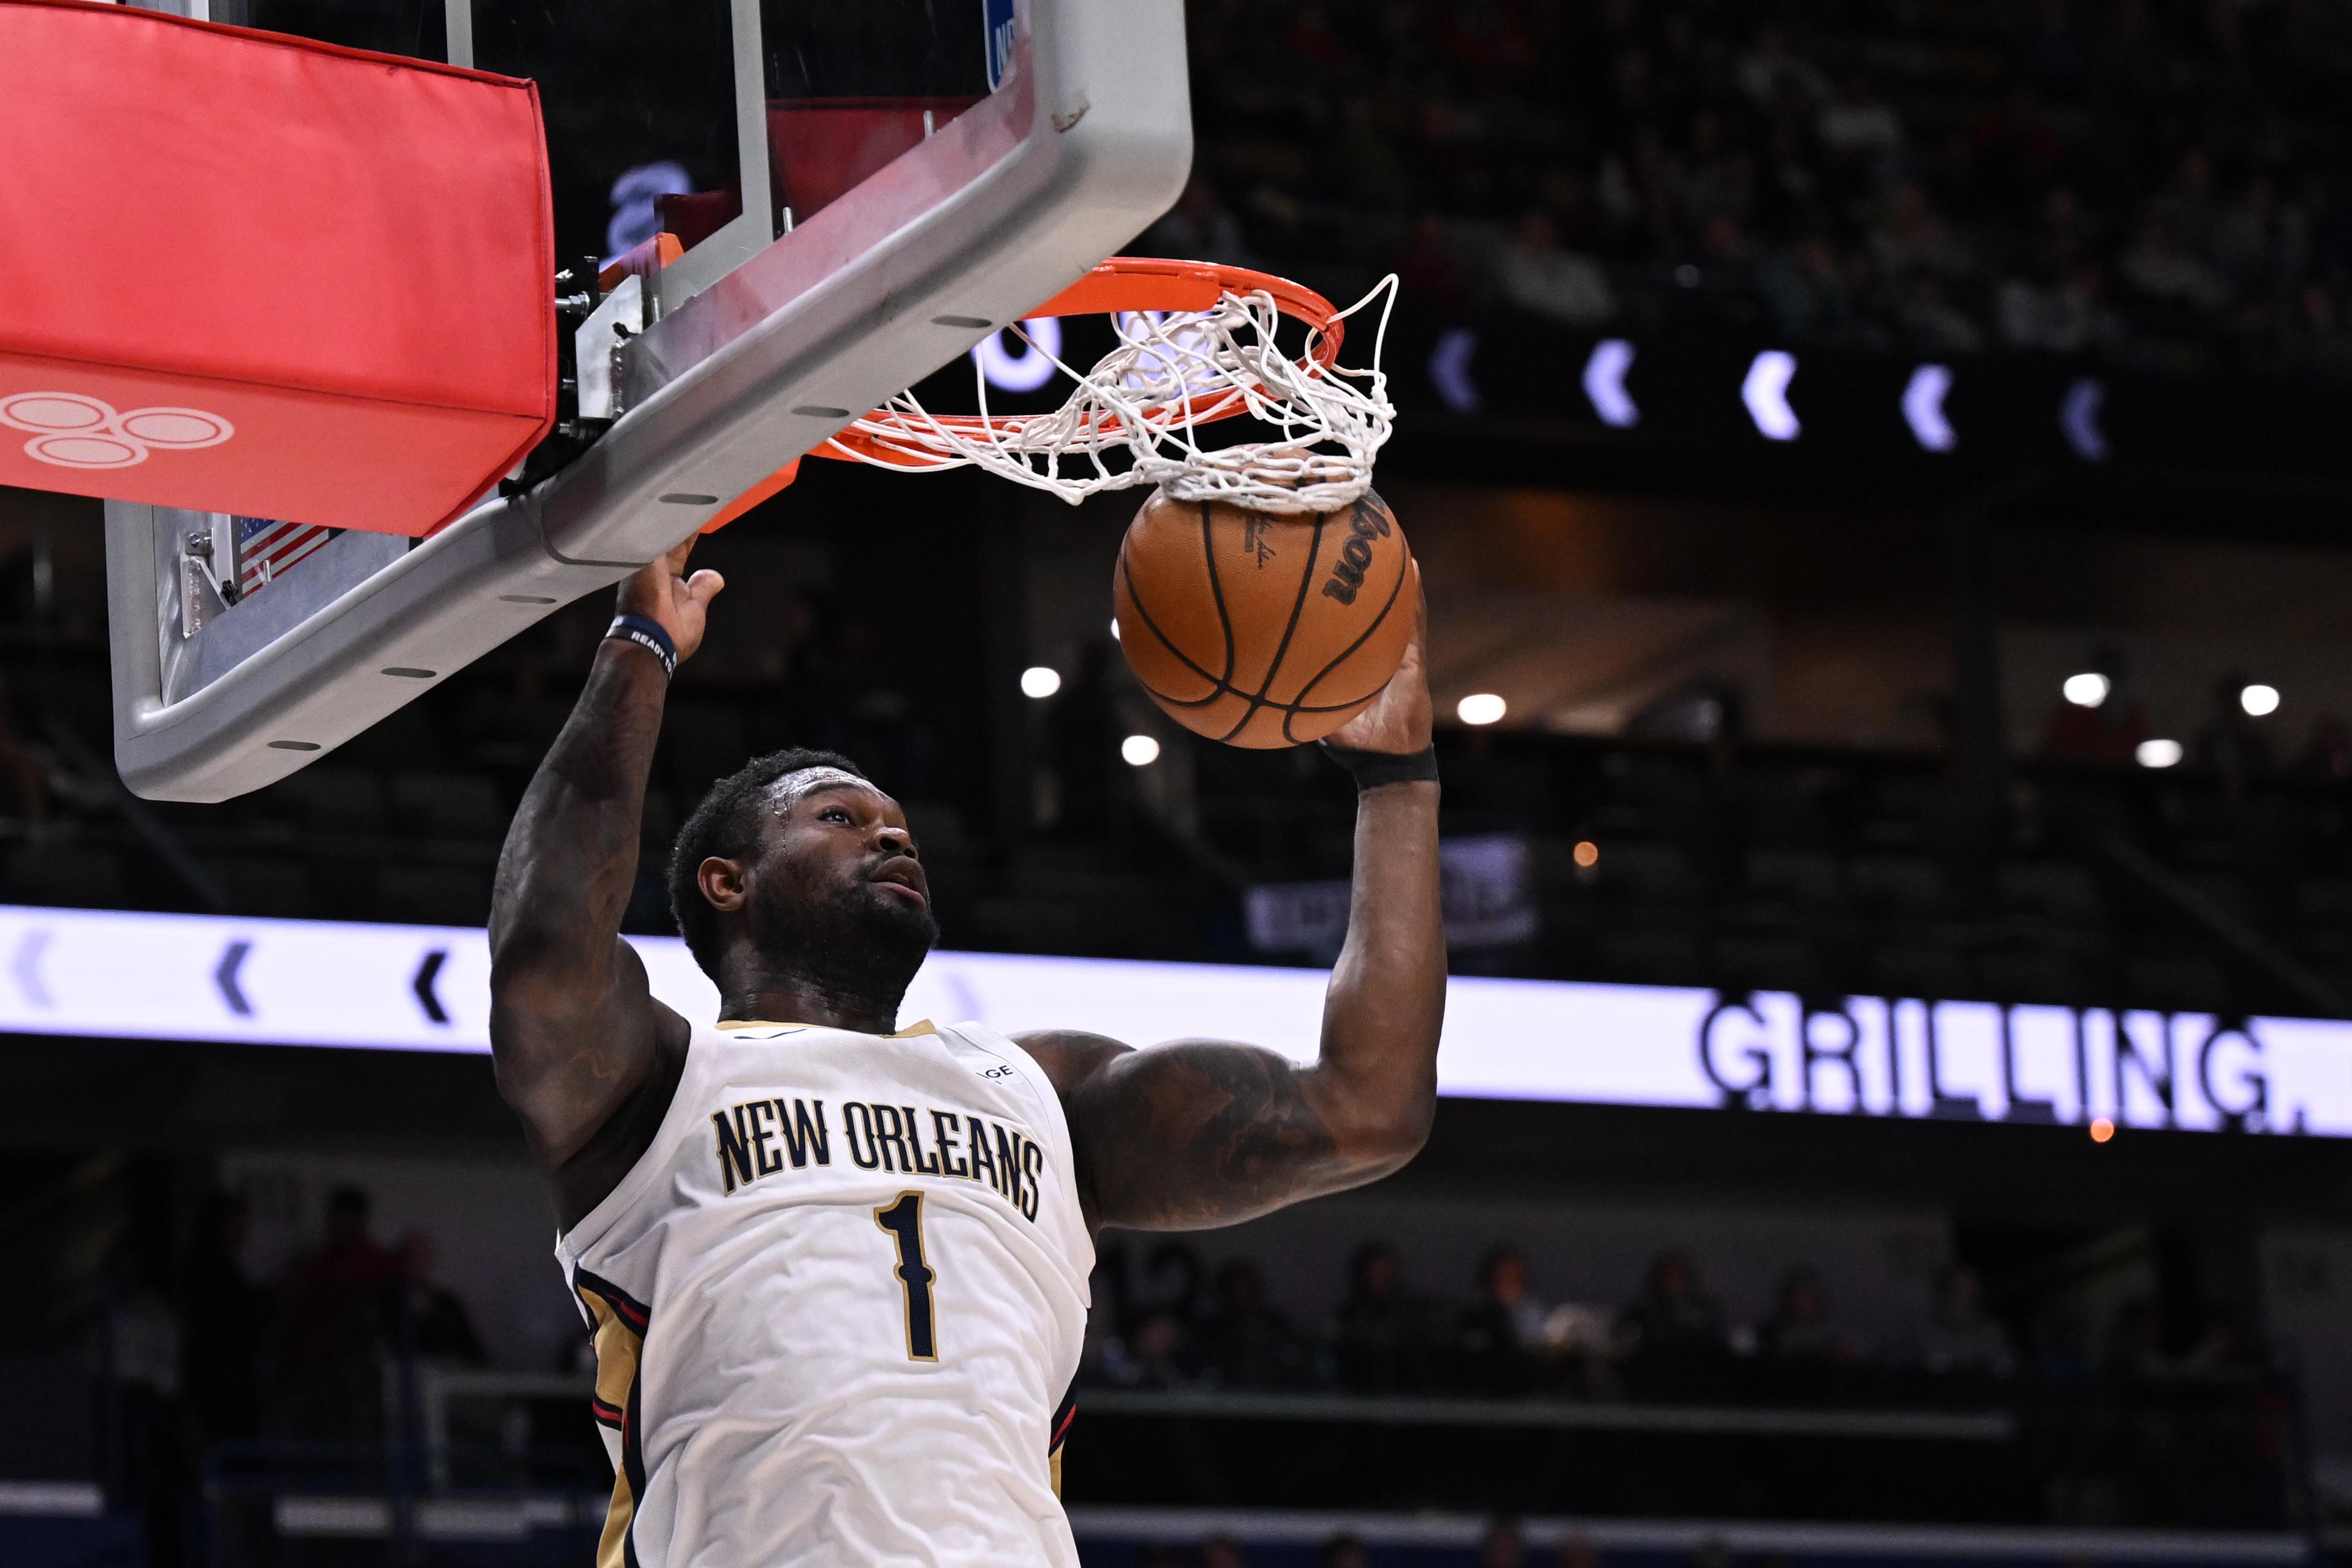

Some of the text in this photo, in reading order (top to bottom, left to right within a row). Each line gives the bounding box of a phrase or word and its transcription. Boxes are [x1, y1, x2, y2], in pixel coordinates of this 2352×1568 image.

[631, 631, 665, 659] READY
[665, 656, 672, 673] TO
[710, 1097, 1043, 1224] NEW ORLEANS
[874, 1189, 939, 1362] 1
